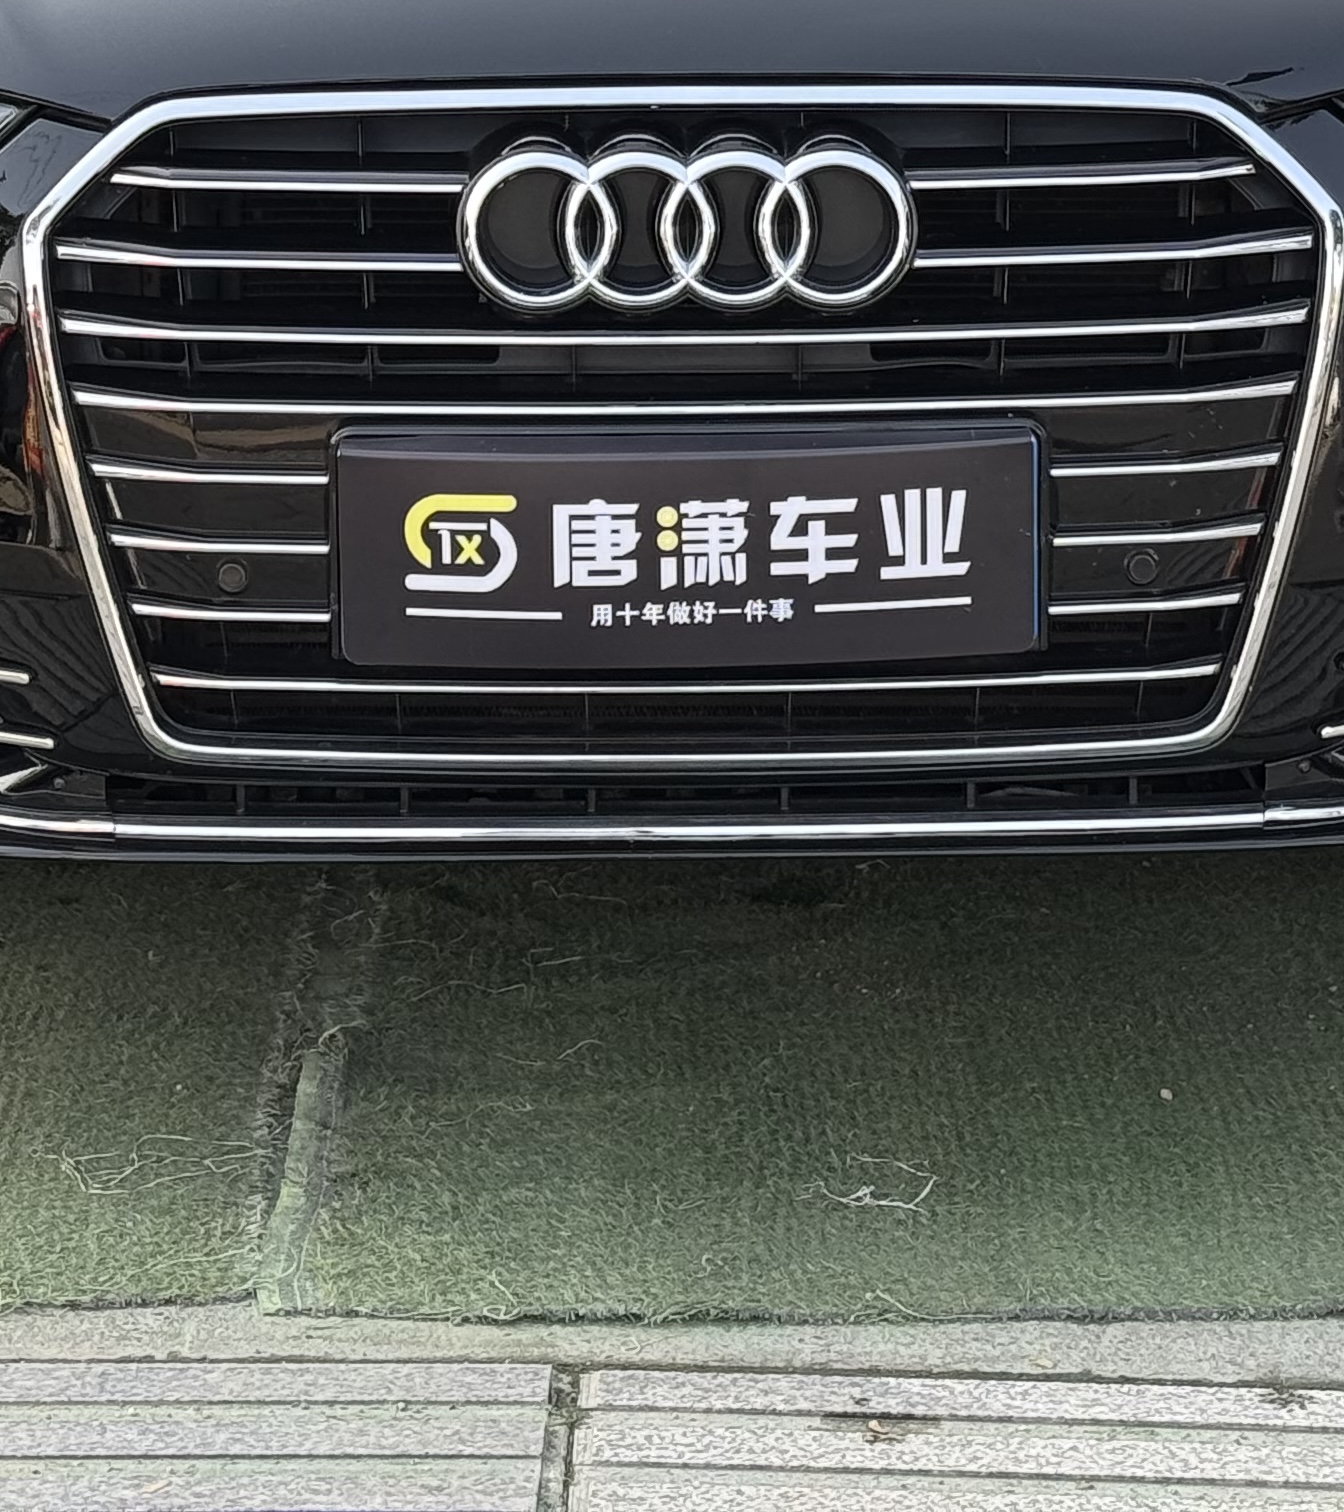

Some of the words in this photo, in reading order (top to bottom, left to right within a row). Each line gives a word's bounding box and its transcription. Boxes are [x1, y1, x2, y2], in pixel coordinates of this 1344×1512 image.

[551, 486, 972, 590] 唐潇车业
[589, 597, 795, 628] 用十年做好一件事
